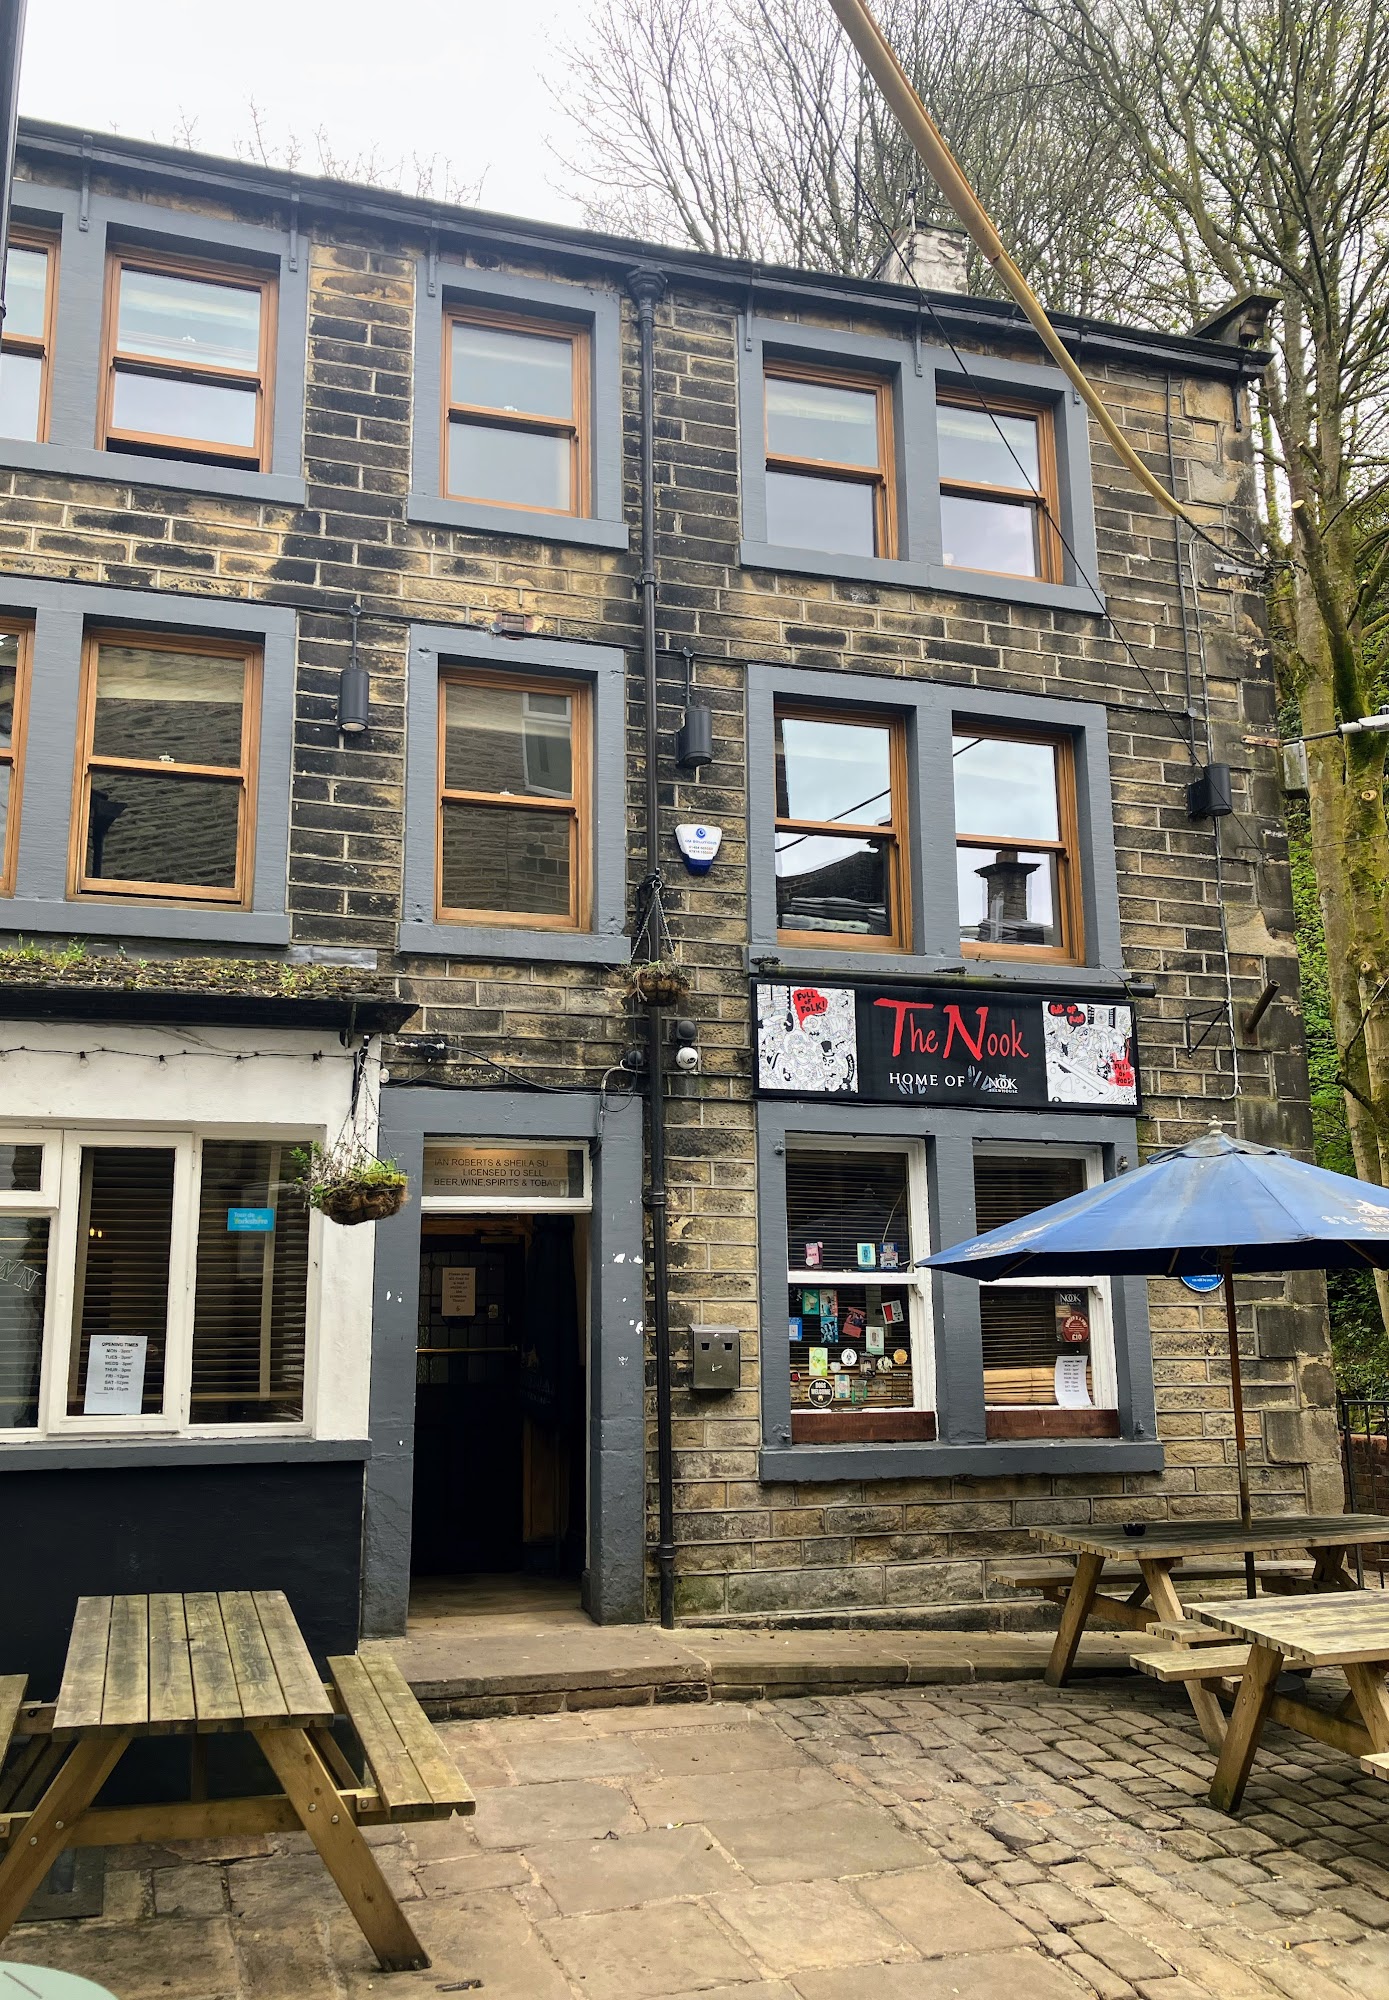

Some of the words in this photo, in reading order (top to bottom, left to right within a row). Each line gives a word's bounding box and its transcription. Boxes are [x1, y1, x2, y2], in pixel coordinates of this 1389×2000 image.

[797, 991, 815, 1002] FULL
[800, 1001, 825, 1014] FOLK!
[873, 998, 939, 1057] The
[942, 1004, 1030, 1061] Nook
[1114, 1063, 1128, 1071] FULL
[889, 1072, 939, 1086] HOME
[944, 1075, 965, 1088] OF
[988, 1077, 1018, 1090] NOOK
[434, 1158, 449, 1166] IAN
[451, 1158, 493, 1167] ROBERTS
[495, 1158, 501, 1167] &
[504, 1159, 536, 1167] SHEILA
[463, 1169, 507, 1177] LICENSED
[510, 1169, 521, 1177] TO
[521, 1179, 527, 1187] &
[1060, 1293, 1082, 1303] NOOK
